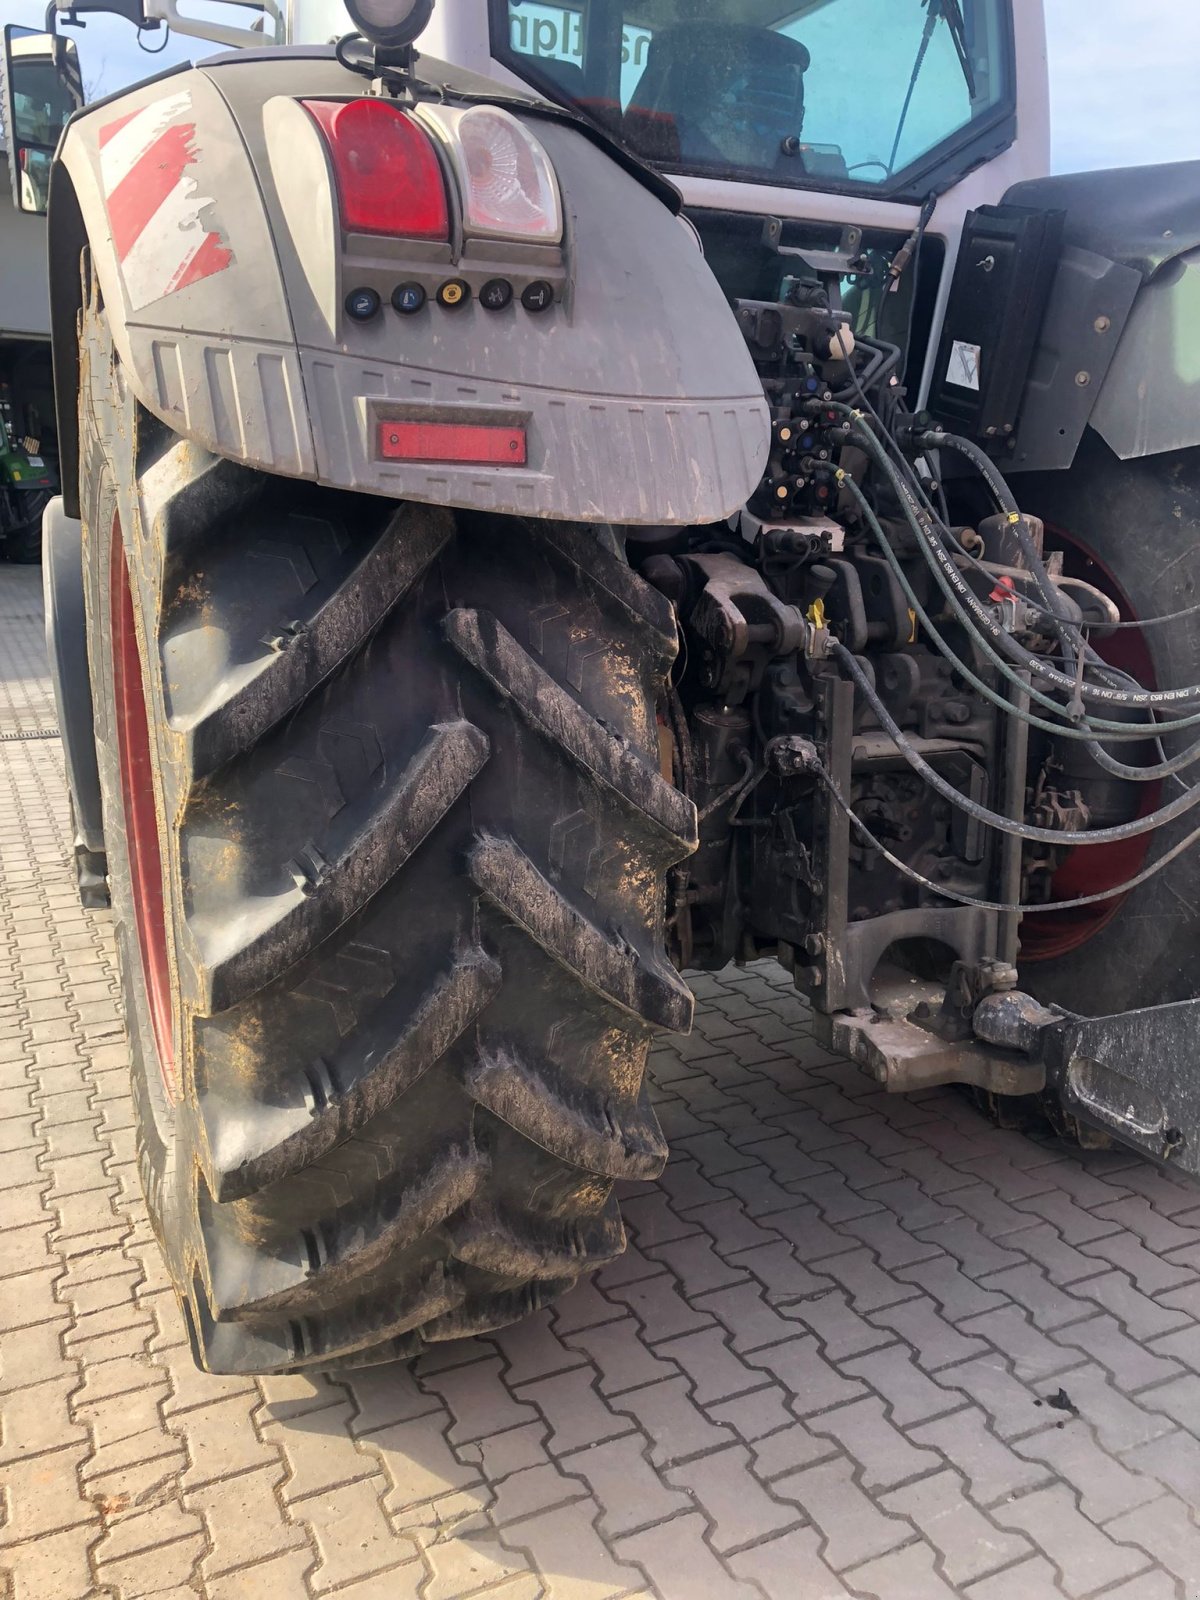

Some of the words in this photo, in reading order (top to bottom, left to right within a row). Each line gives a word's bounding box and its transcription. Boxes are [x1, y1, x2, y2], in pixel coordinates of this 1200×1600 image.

[935, 549, 948, 563] 2SN
[943, 562, 955, 575] 853
[955, 580, 968, 594] DIN
[965, 593, 992, 627] GERMANY
[1092, 688, 1100, 696] 16
[1101, 690, 1113, 699] DN
[1164, 692, 1175, 700] EN
[1175, 690, 1189, 699] DIN
[1133, 694, 1148, 702] 2SN
